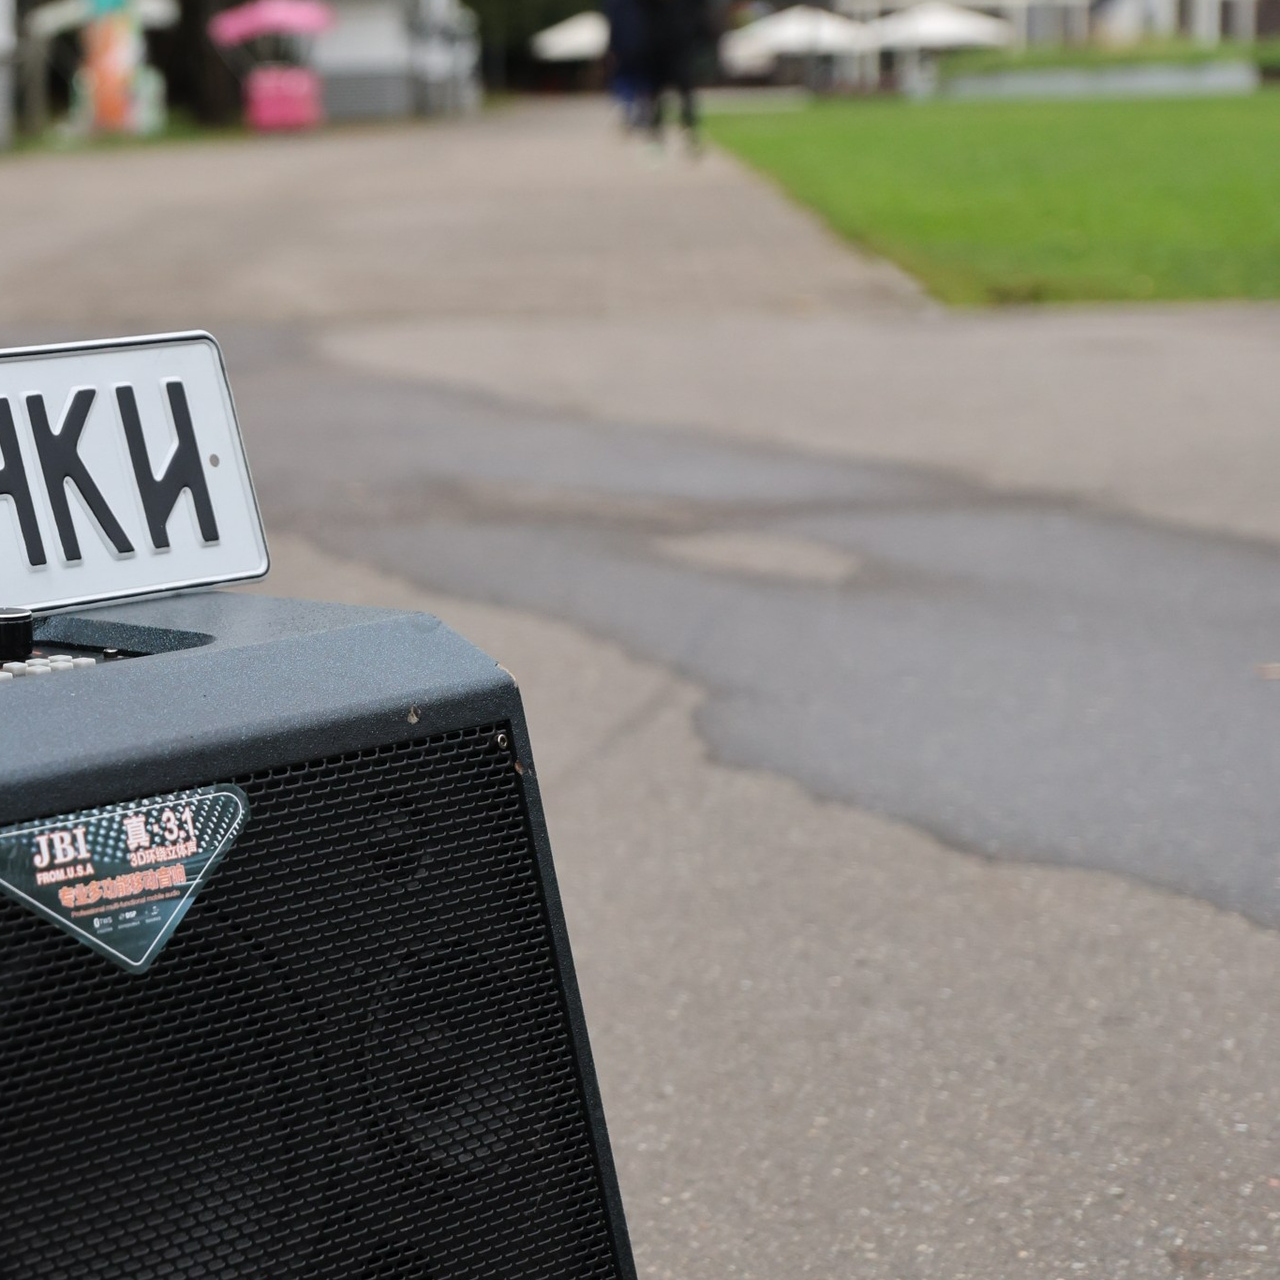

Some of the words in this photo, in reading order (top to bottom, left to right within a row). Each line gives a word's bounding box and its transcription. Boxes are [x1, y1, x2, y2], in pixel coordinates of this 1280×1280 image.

[33, 826, 91, 868] JBI
[58, 862, 187, 909] 专业多功能移动音响
